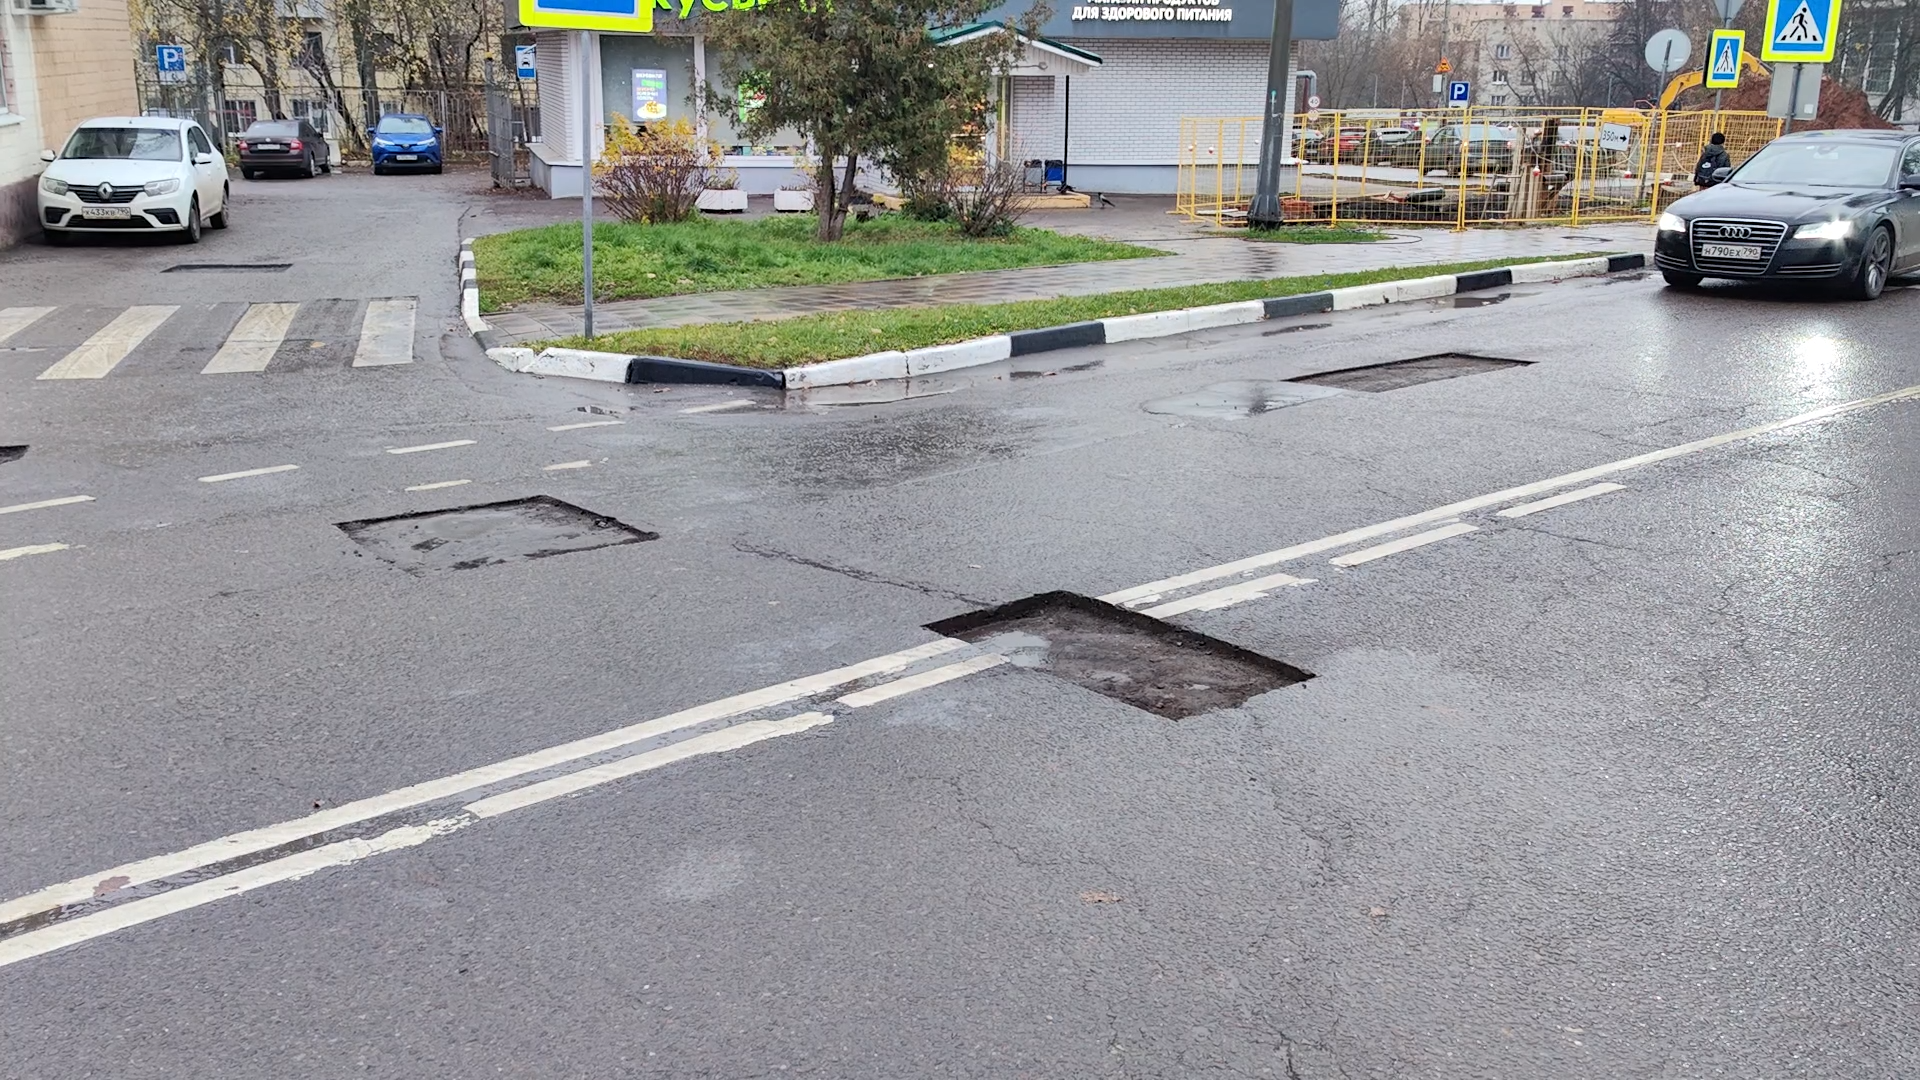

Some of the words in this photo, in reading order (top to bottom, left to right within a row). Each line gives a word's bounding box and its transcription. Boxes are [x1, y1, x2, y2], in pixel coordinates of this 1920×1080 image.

[1072, 6, 1099, 20] ДЛЯ
[1101, 7, 1174, 21] ЗДОРОВОГО
[1176, 8, 1232, 21] ПИТАНИЯ
[163, 49, 178, 69] P
[1453, 84, 1466, 99] P
